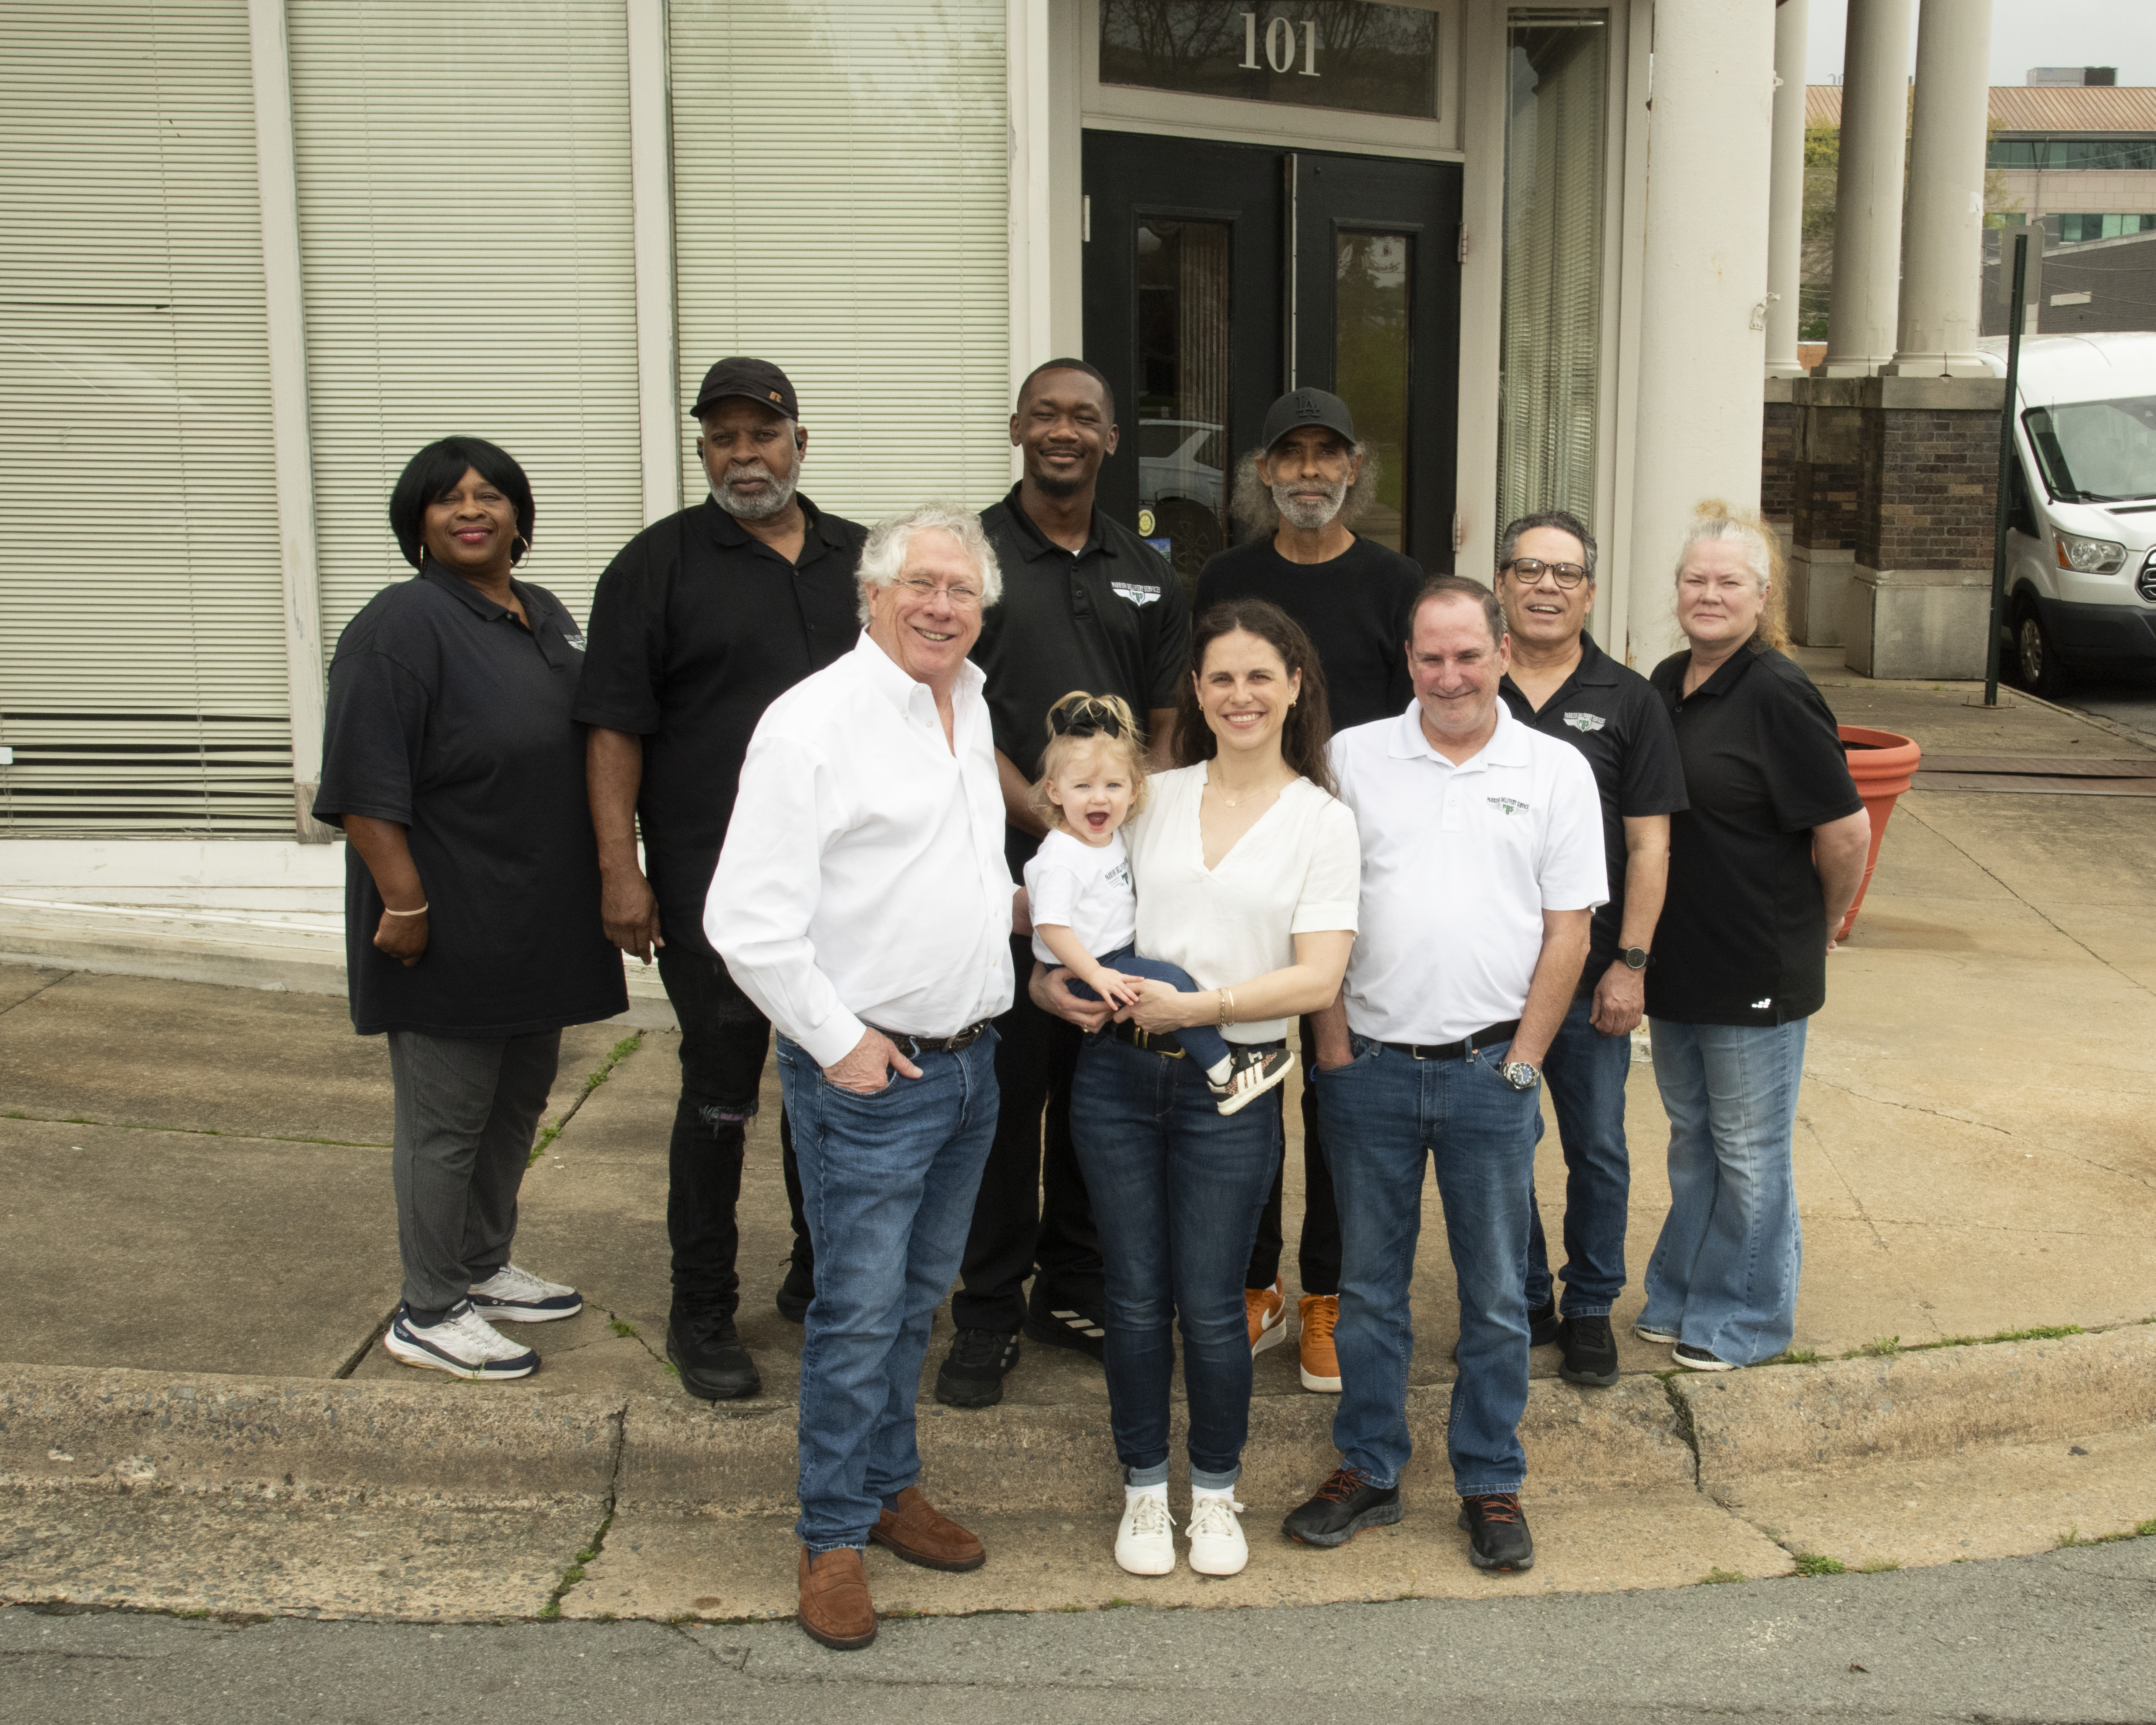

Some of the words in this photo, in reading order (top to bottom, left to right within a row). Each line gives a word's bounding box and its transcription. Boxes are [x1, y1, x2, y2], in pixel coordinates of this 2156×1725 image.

[1239, 13, 1320, 76] 101
[1296, 395, 1320, 419] LA
[1127, 583, 1144, 591] DELIVERY
